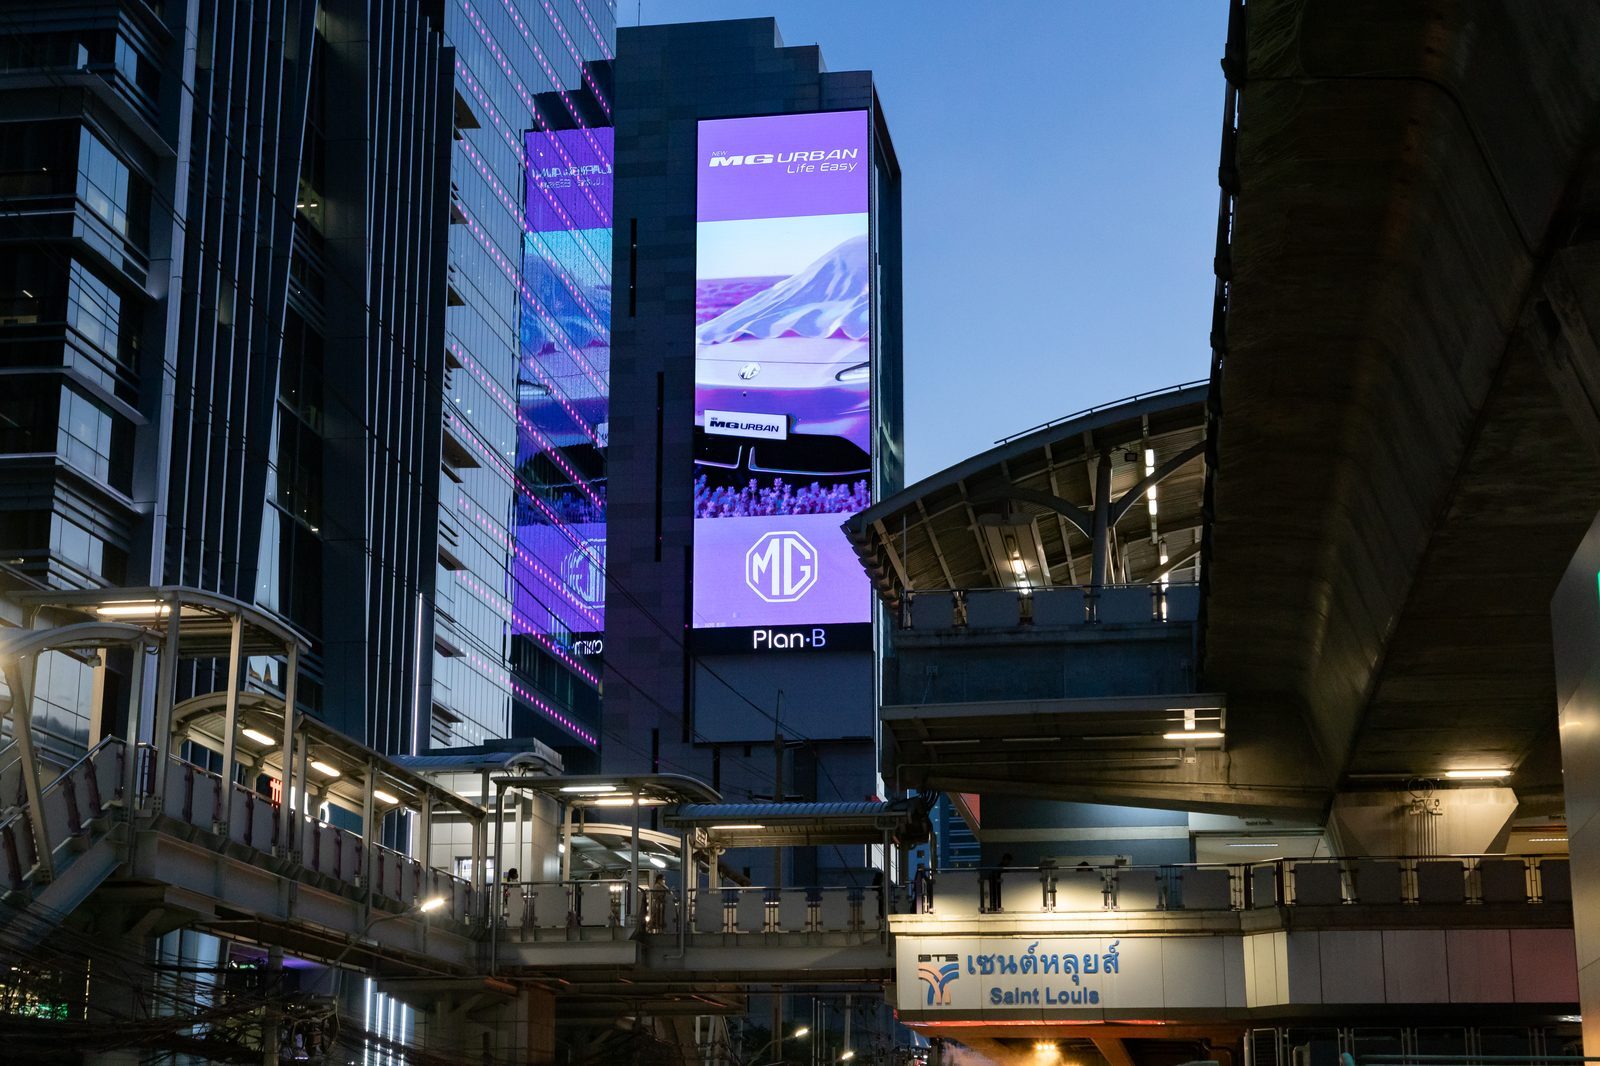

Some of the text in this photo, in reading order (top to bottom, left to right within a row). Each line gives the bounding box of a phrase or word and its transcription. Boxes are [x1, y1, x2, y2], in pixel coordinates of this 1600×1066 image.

[709, 148, 859, 167] MG URBAN
[786, 162, 858, 174] Life Easy
[709, 420, 780, 433] MG URBAN
[752, 537, 811, 596] MG
[918, 953, 959, 963] BTS
[967, 940, 1120, 986] เซนต์หลุยส์
[990, 987, 1100, 1005] Saint Louis
